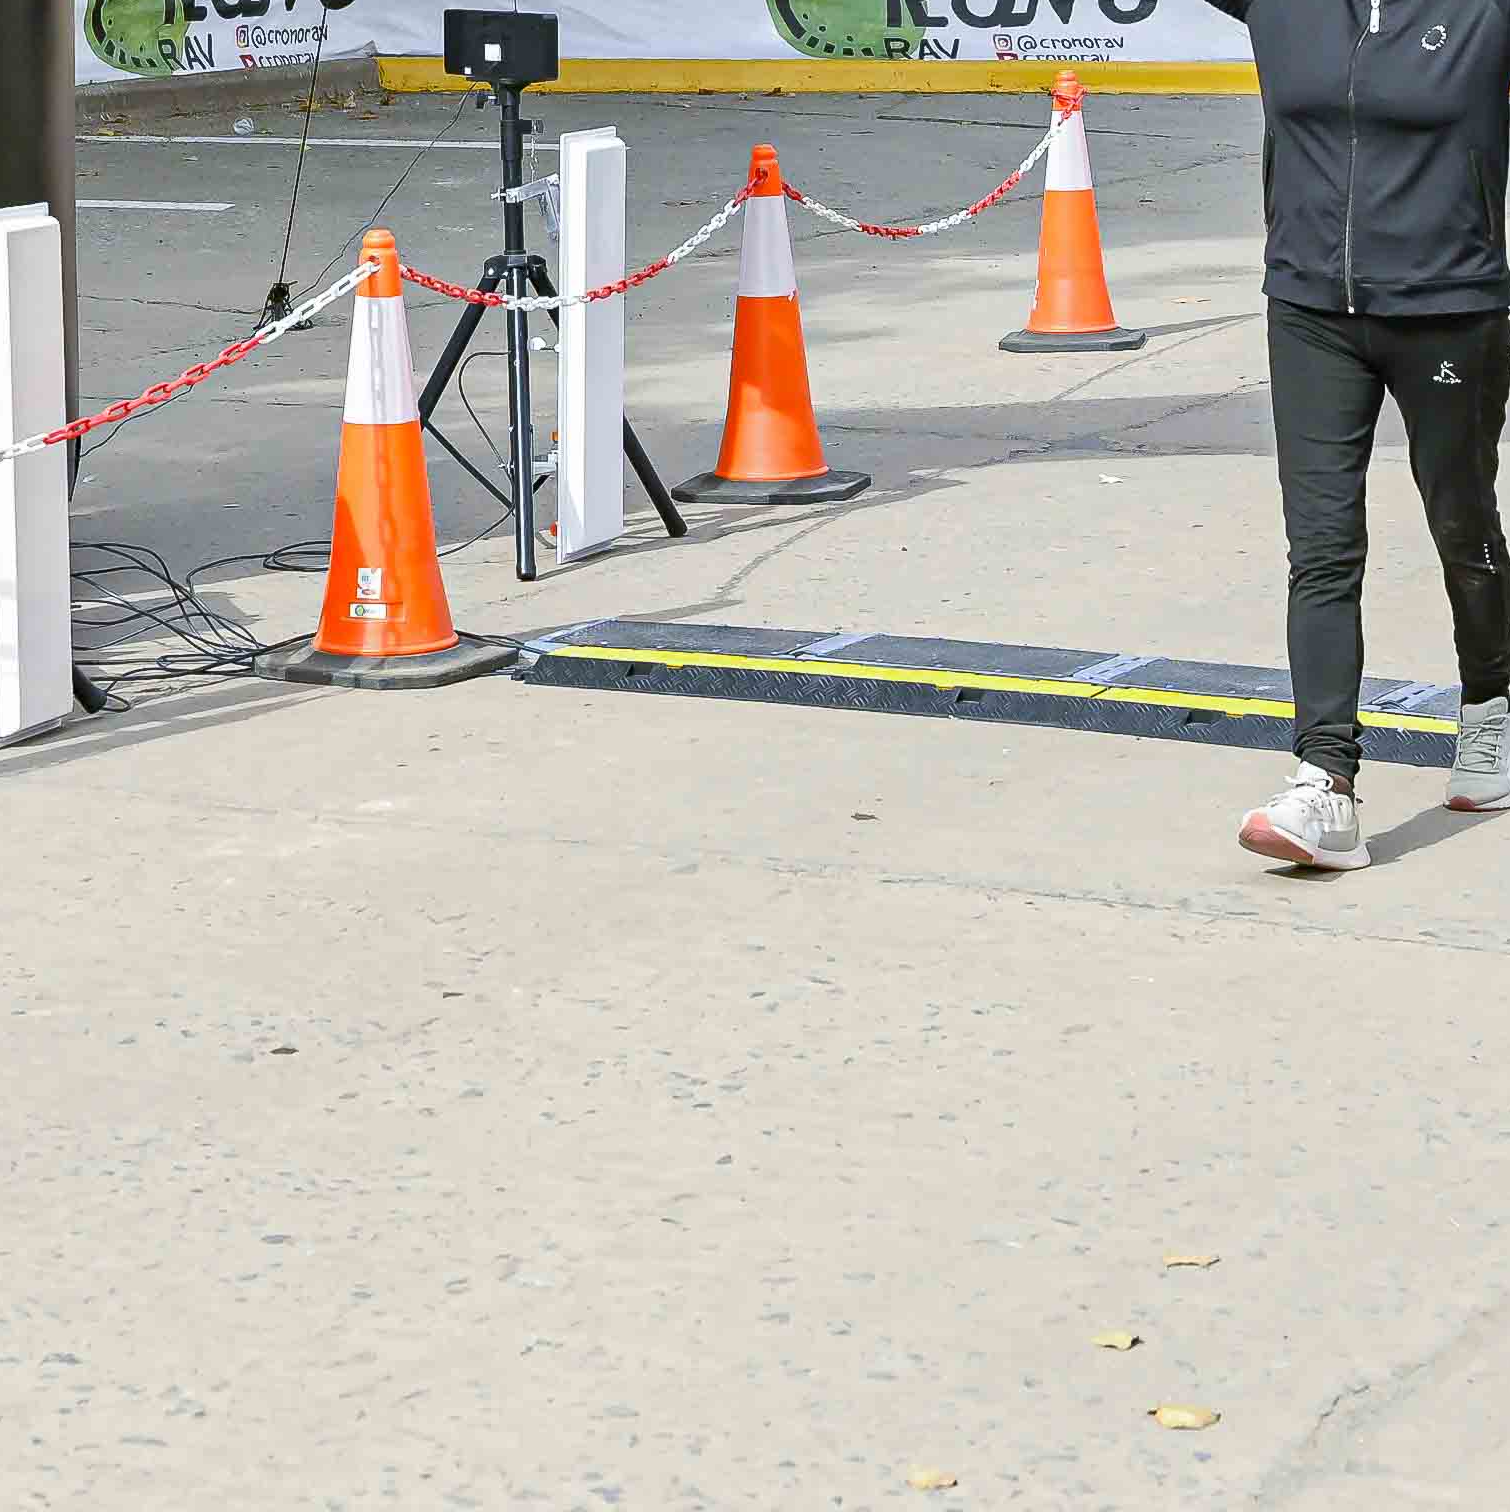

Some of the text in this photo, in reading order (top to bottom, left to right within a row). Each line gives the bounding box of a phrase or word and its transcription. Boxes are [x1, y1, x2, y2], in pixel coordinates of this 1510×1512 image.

[159, 33, 215, 71] RAV
[885, 35, 1124, 60] RAV @cronorav
